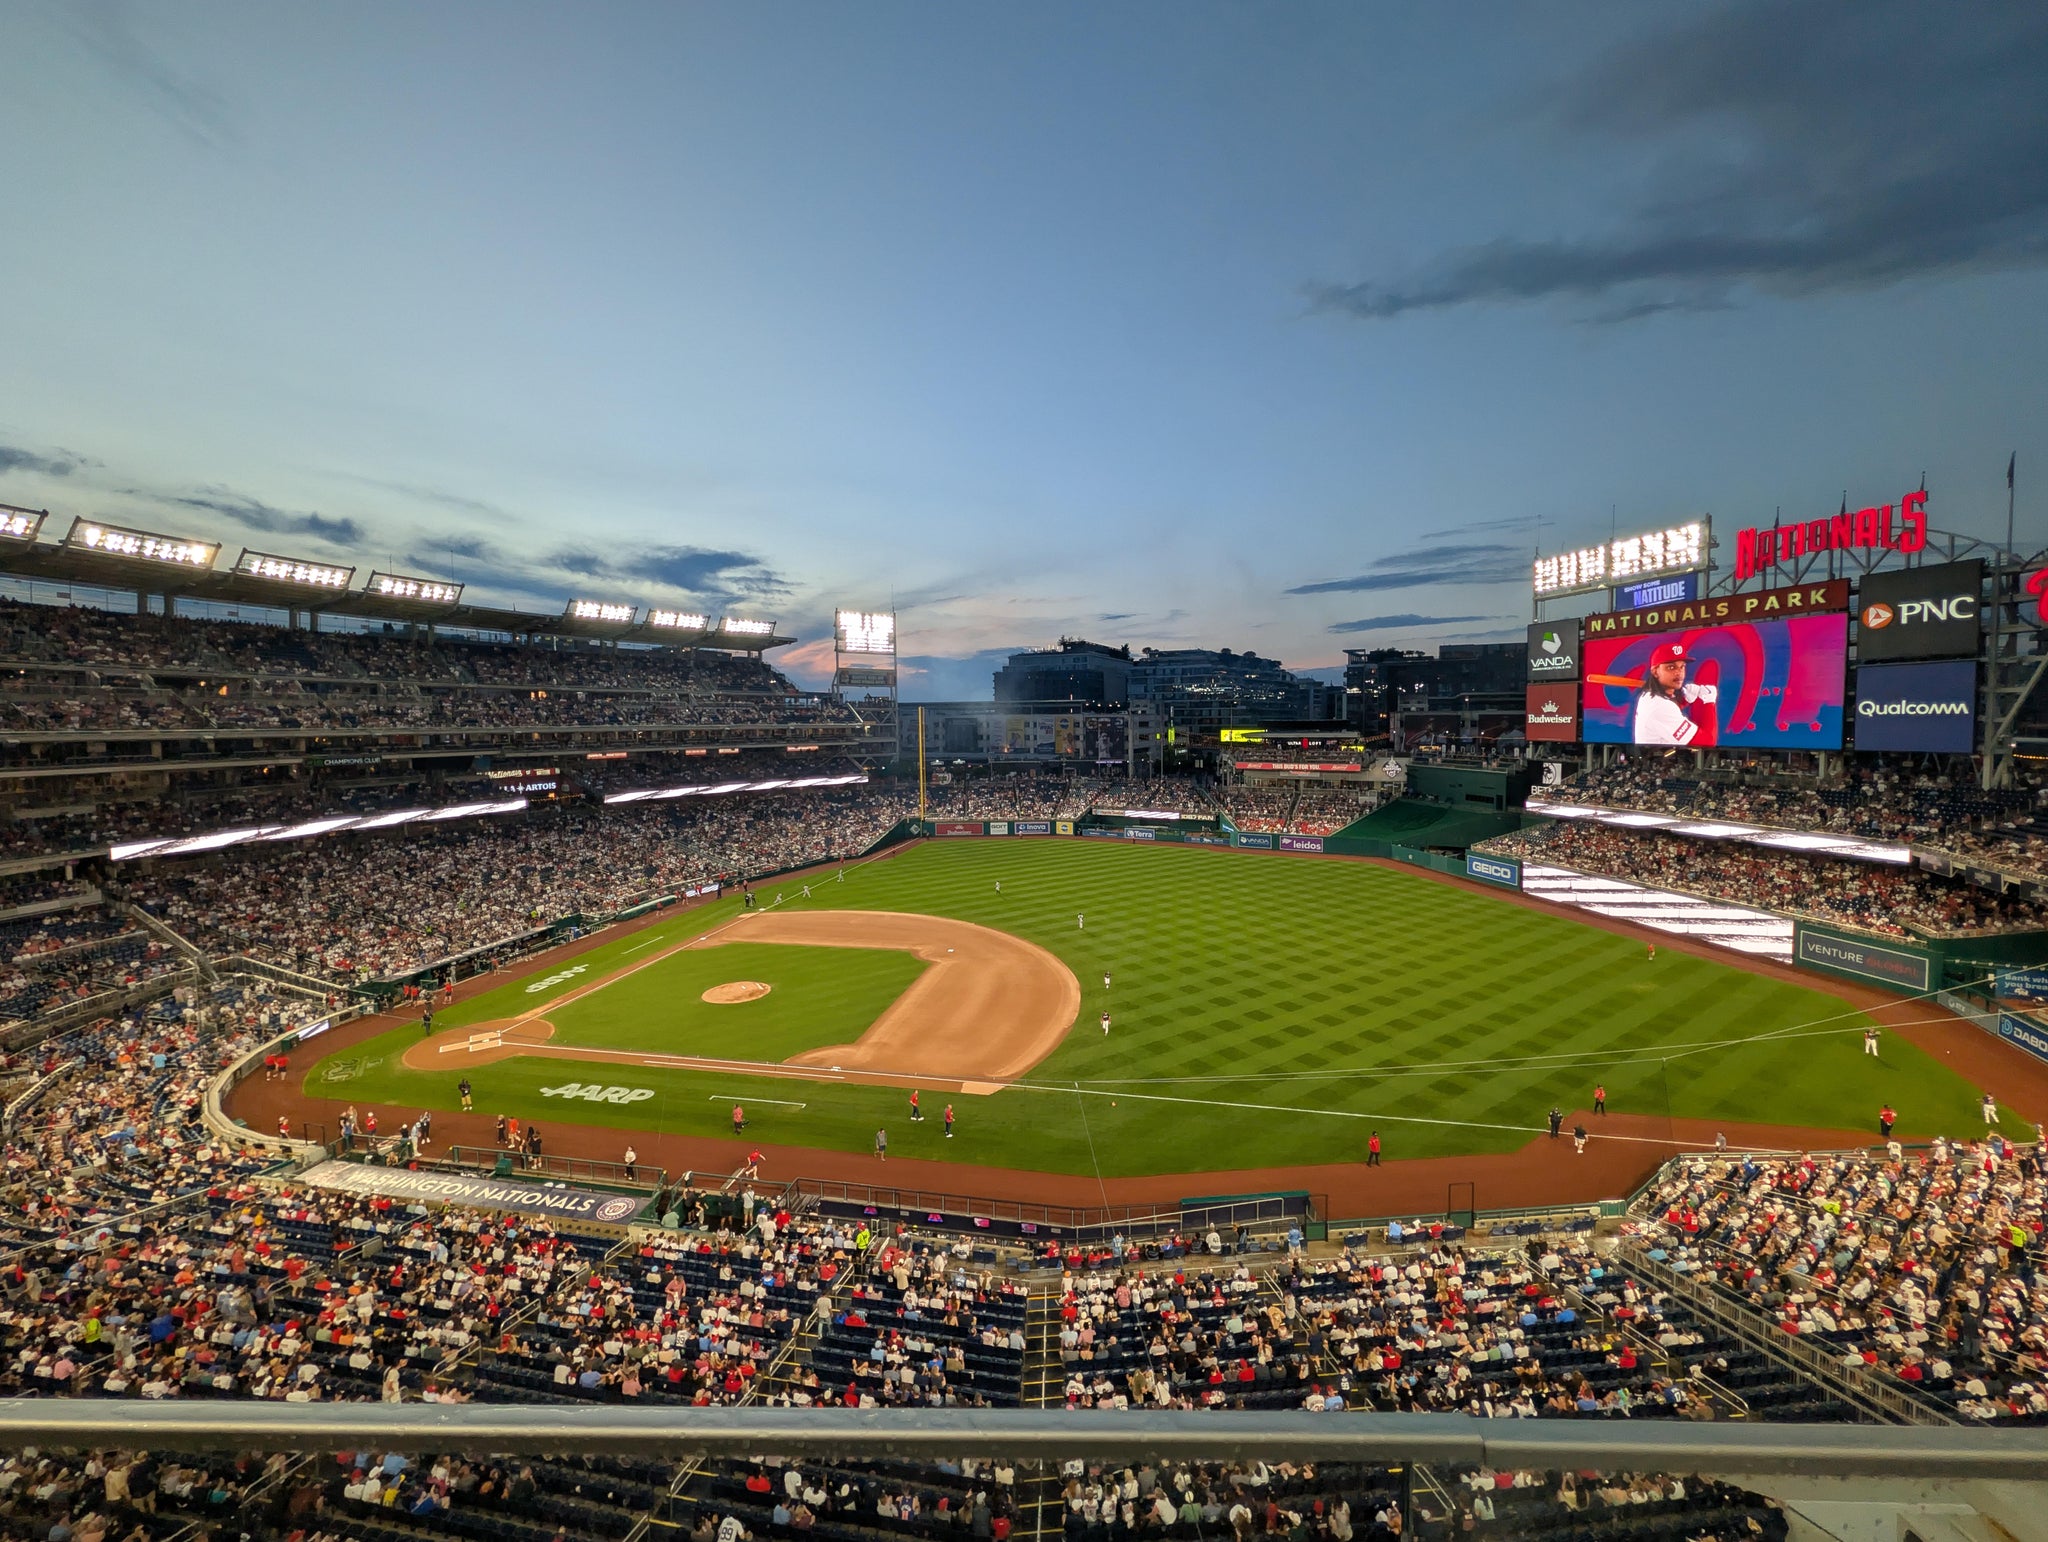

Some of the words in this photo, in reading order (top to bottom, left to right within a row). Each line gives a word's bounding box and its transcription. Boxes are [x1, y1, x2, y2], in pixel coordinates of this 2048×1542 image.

[1735, 489, 1928, 580] NATIONALS
[1633, 581, 1686, 606] NATITUDE
[1590, 602, 1729, 633] NATIONALS
[1745, 588, 1828, 613] PARK
[1897, 596, 1975, 624] PNC
[1530, 655, 1574, 668] VANDA
[1858, 699, 1969, 717] Qualcomm
[1527, 714, 1573, 724] Budweiser
[525, 782, 557, 792] ARTOIS
[1134, 830, 1153, 838] Terra
[1293, 840, 1321, 850] leidos
[1472, 861, 1511, 879] GEICO
[1807, 941, 1864, 964] VENTURE
[2005, 973, 2030, 982] Bank
[539, 1083, 656, 1105] AARP
[346, 1169, 473, 1198] WASHINGTON
[479, 1187, 596, 1212] NATIONALS
